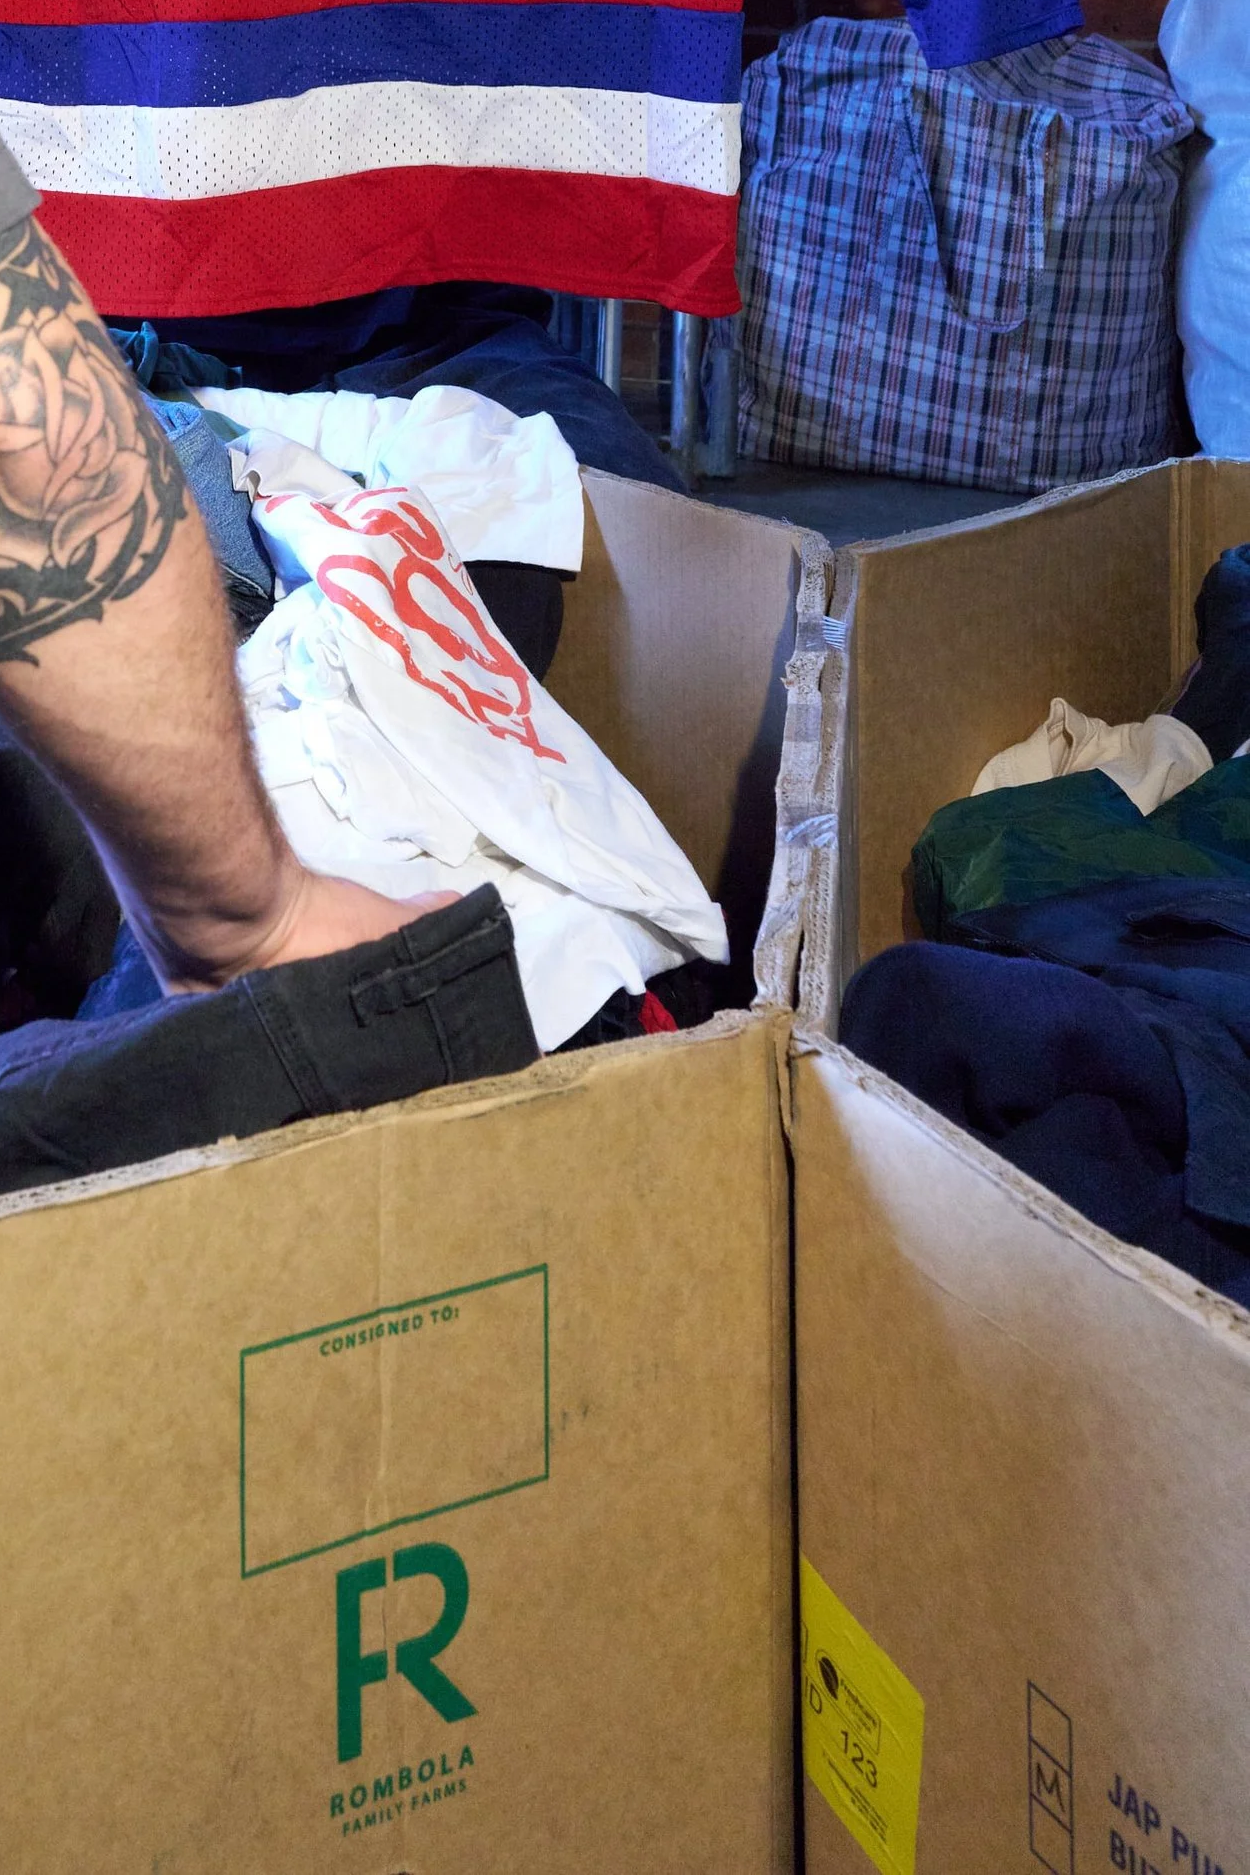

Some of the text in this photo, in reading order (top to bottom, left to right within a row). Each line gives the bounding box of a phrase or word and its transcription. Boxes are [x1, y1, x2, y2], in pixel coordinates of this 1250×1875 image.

[319, 1305, 459, 1357] CONSIGNED TO:
[330, 1744, 475, 1818] ROMBOLA
[841, 1730, 878, 1789] 123
[1036, 1762, 1066, 1813] M
[342, 1778, 467, 1837] FAMILY FARMS
[1108, 1773, 1162, 1836] JAP
